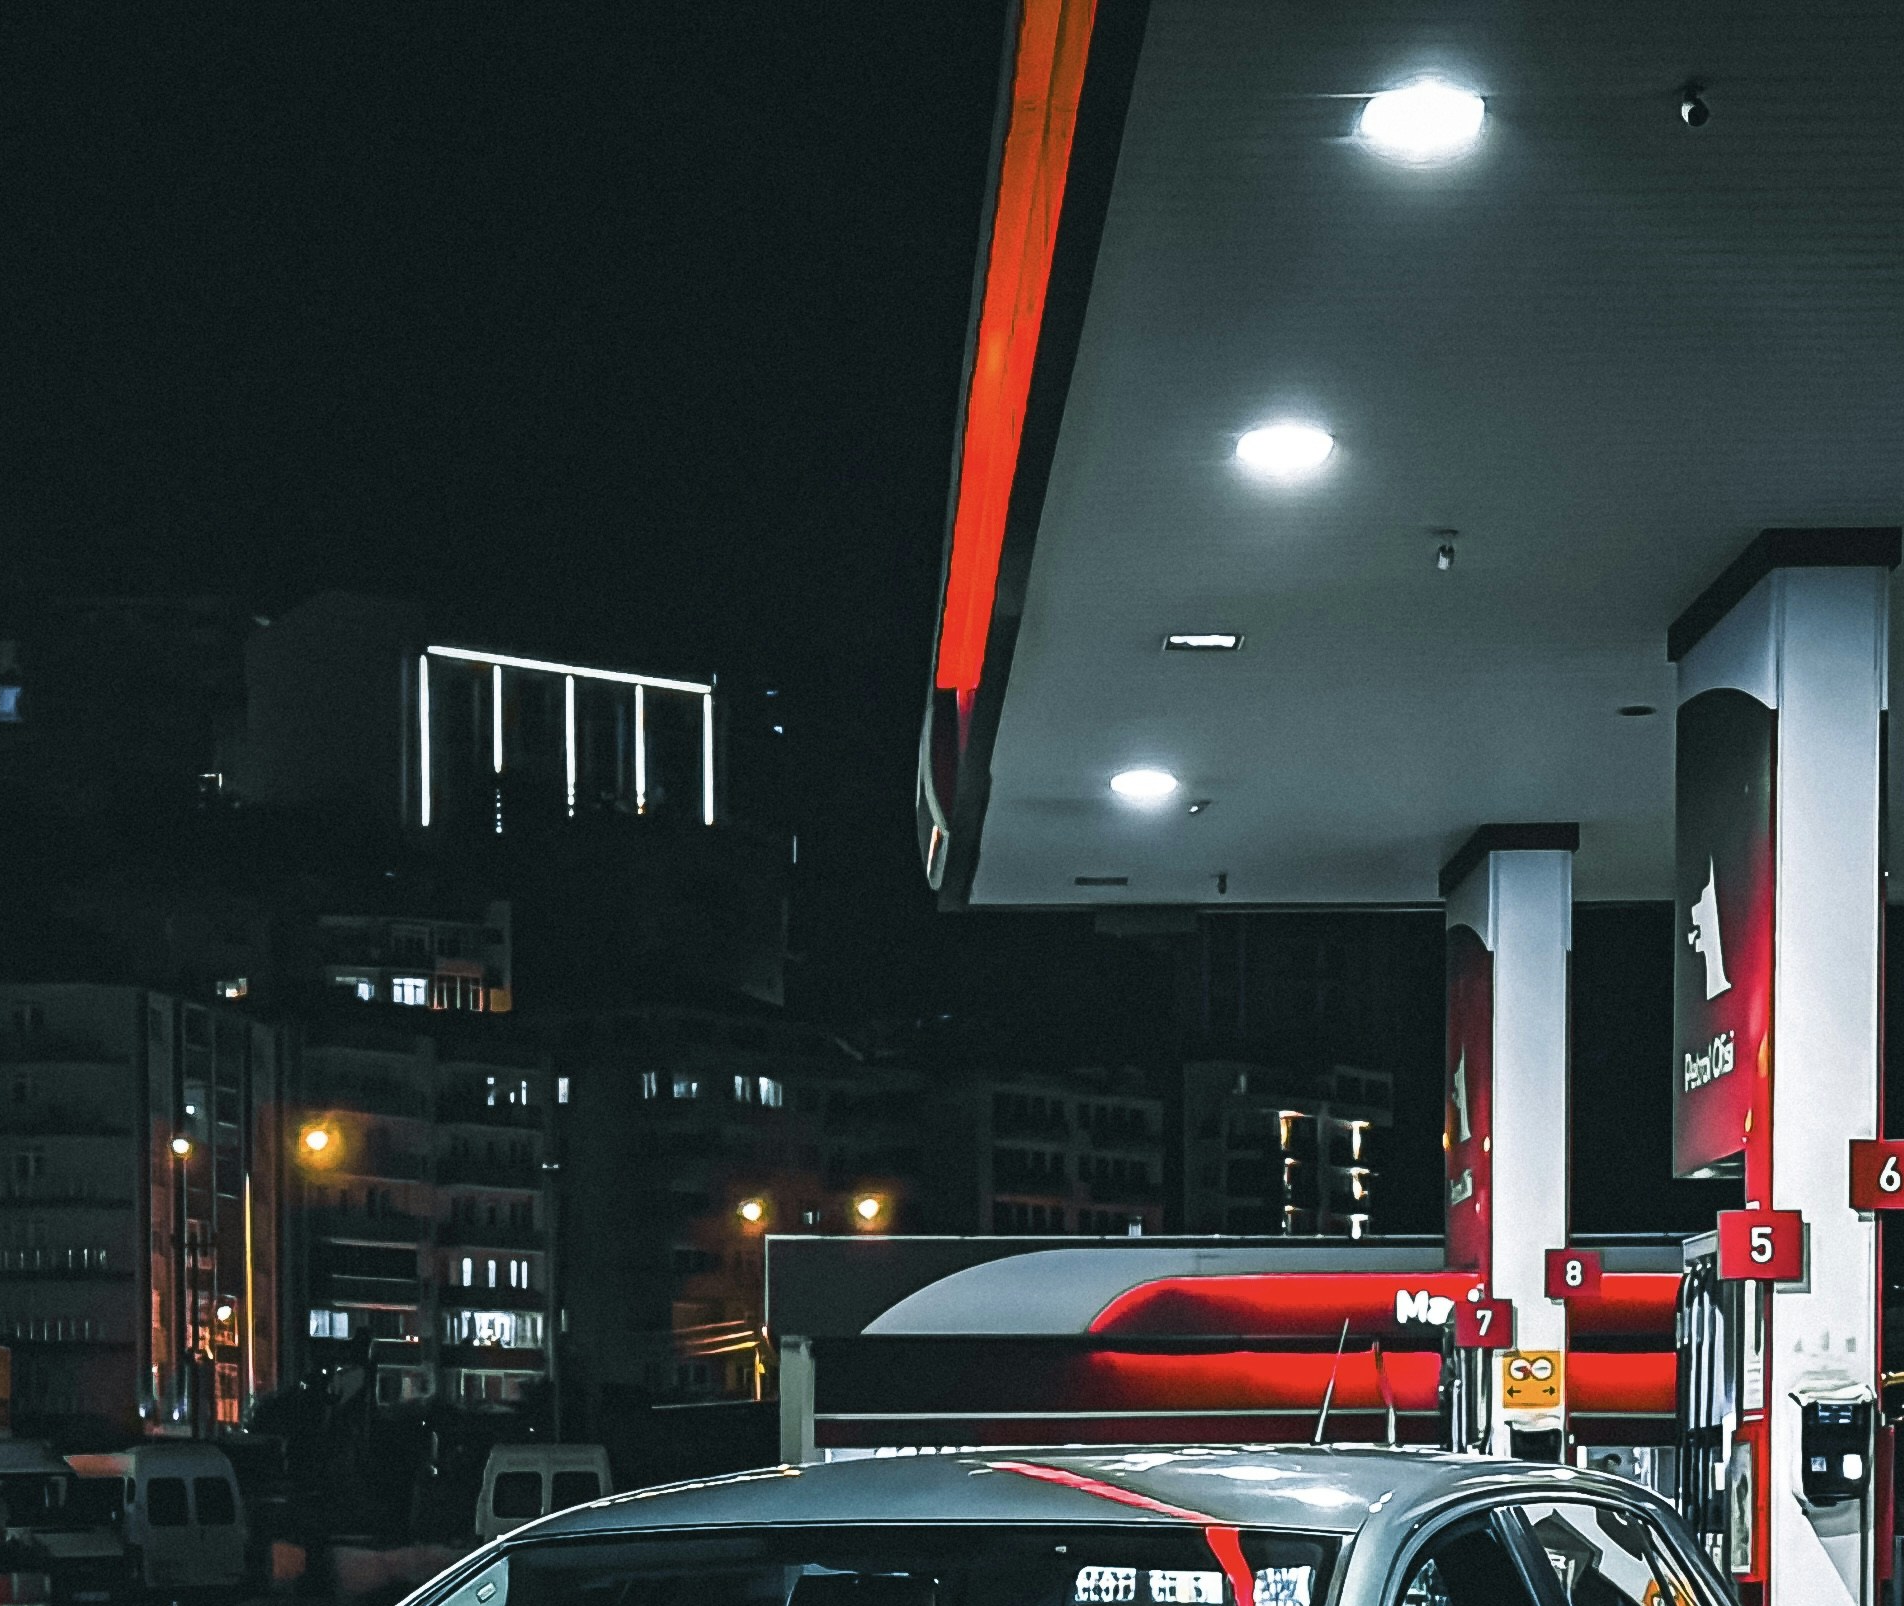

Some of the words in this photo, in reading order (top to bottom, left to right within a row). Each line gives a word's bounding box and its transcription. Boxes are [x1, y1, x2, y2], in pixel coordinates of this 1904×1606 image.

[1879, 1156, 1901, 1192] 6
[1750, 1226, 1773, 1263] 5
[1565, 1260, 1582, 1287] 8
[1396, 1289, 1455, 1326] Ma
[1476, 1309, 1493, 1336] 7
